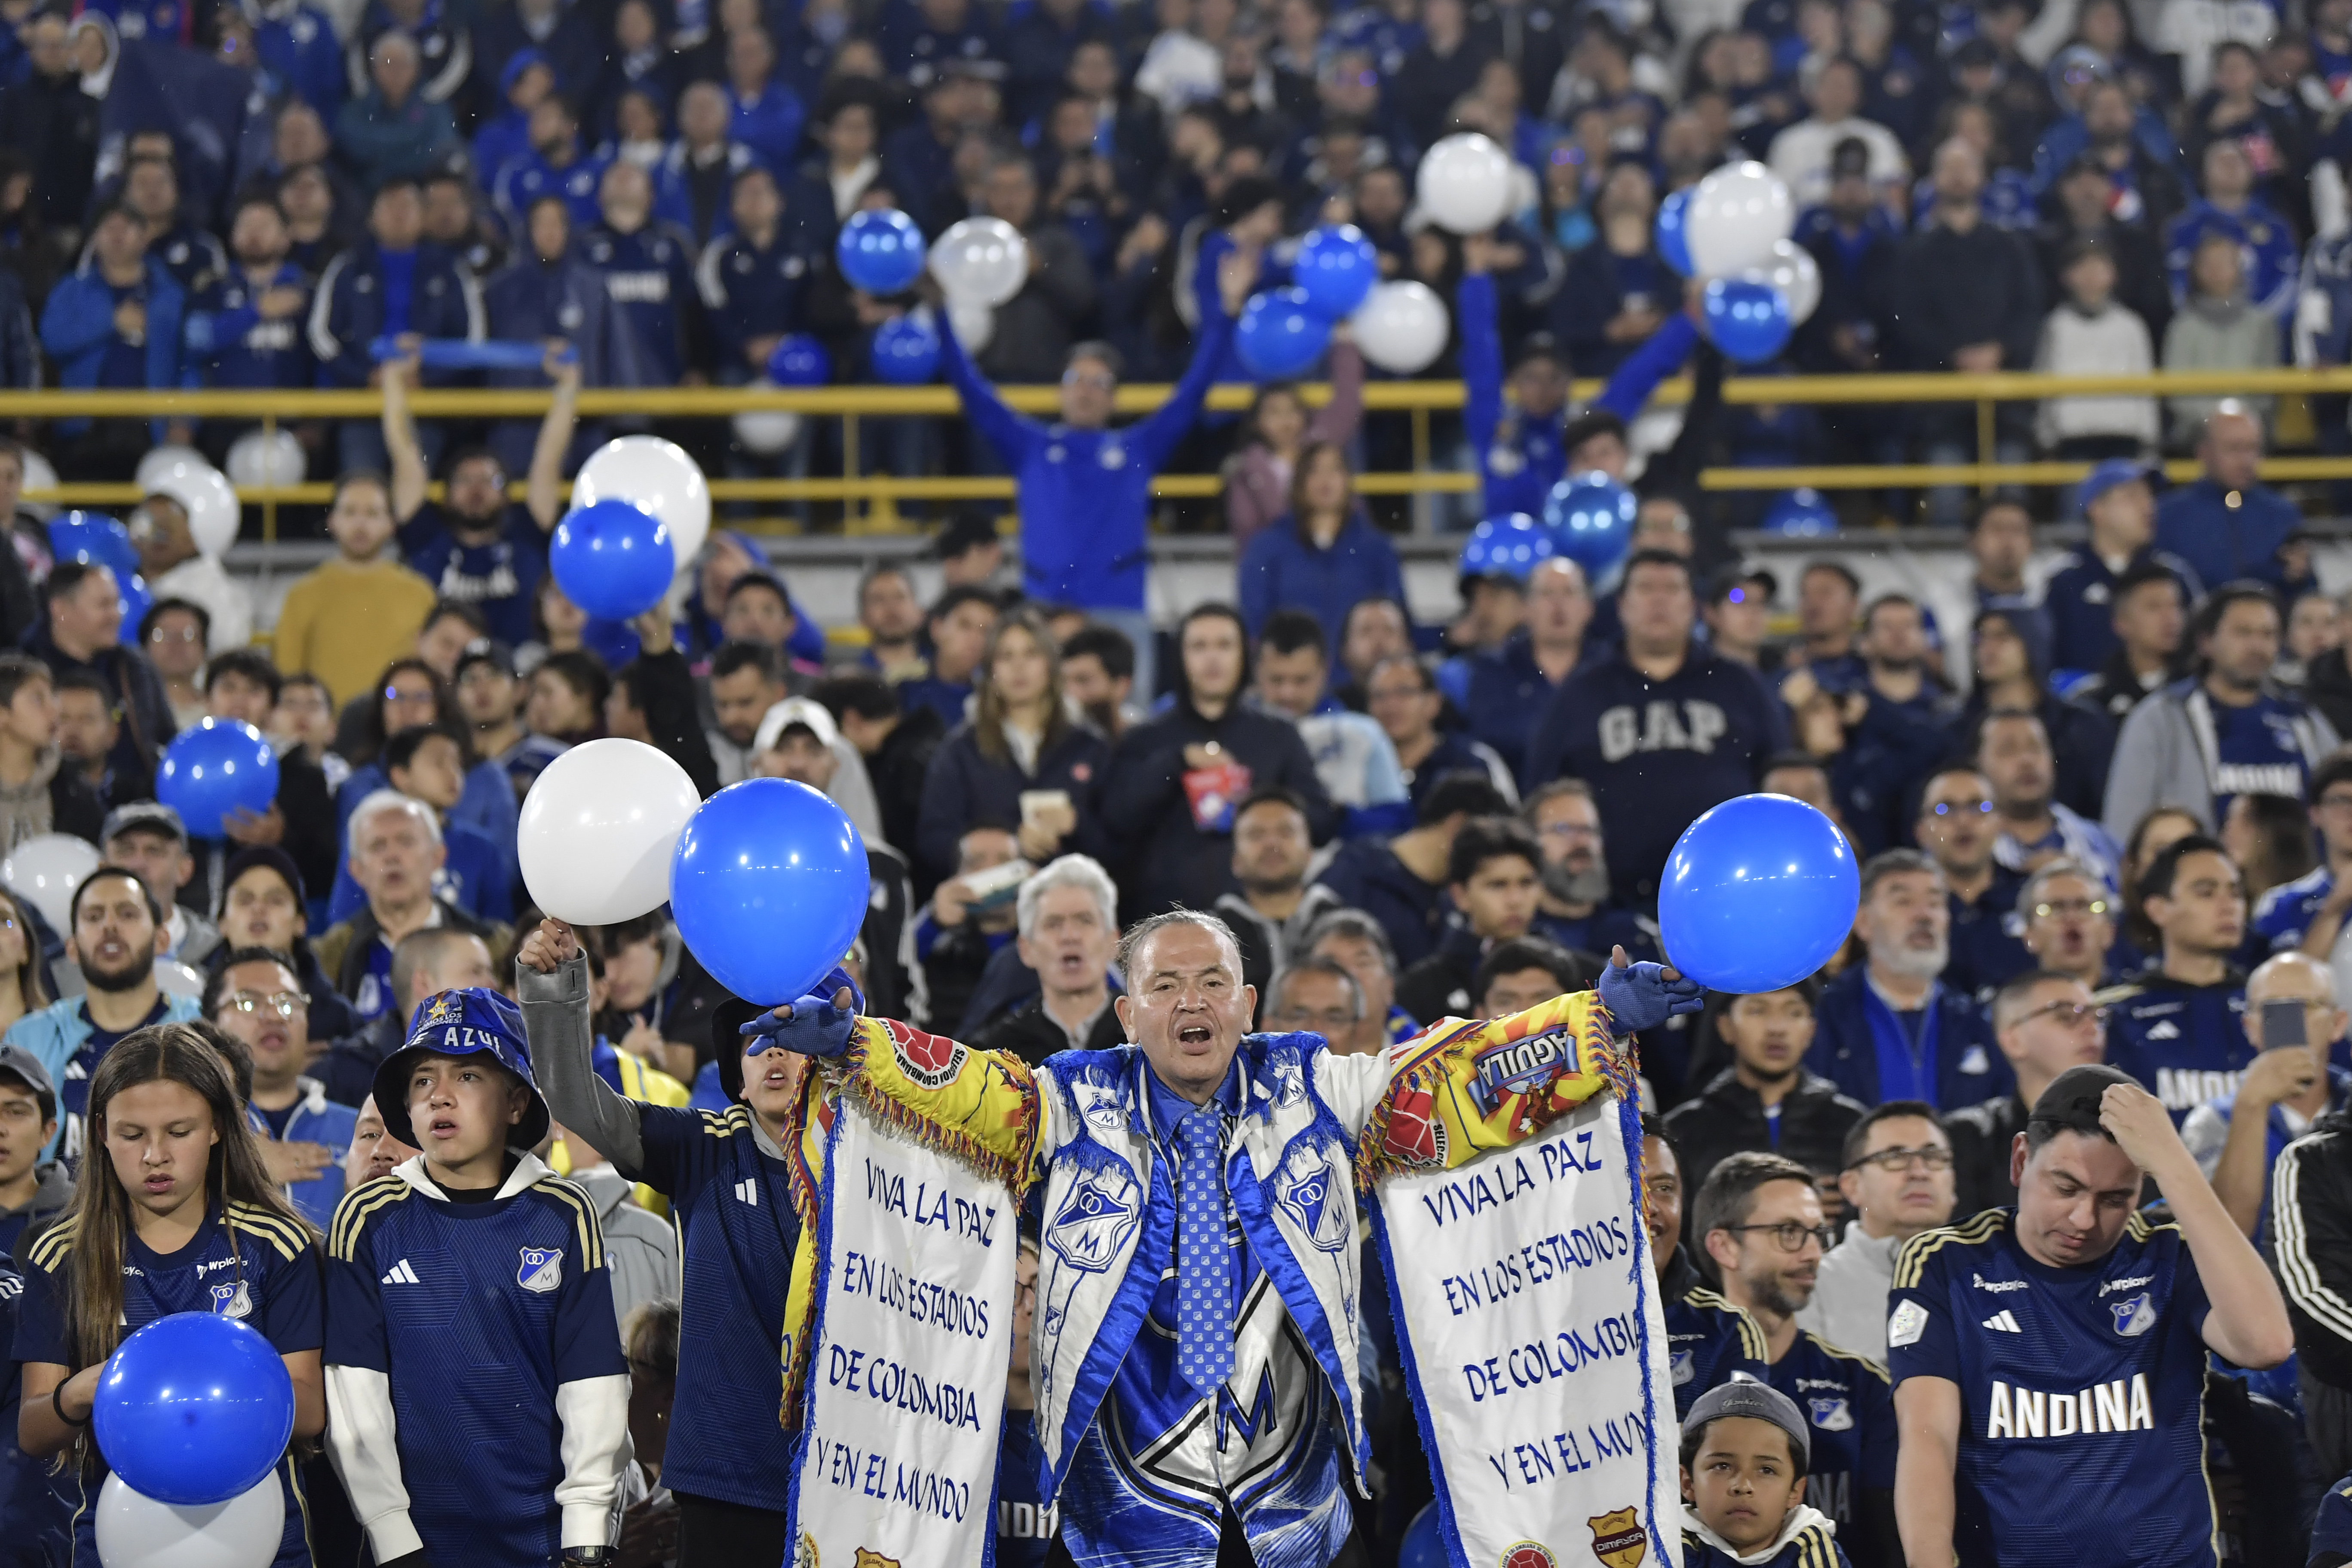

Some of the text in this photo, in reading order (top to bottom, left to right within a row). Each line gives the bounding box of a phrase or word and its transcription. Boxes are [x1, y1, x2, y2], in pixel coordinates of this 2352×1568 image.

[1598, 697, 1727, 764] GAP
[1477, 1031, 1568, 1087] AGUILA
[865, 1157, 996, 1248] VIVA LA PAZ
[1423, 1130, 1602, 1228] VIVA LA PAZ
[843, 1251, 988, 1339] EN LOS ESTADIOS
[1441, 1216, 1628, 1316] EN LOS ESTADIOS
[829, 1344, 981, 1433] DE COLOMBIA
[1462, 1356, 1508, 1402] DE
[1987, 1372, 2155, 1439] ANDINA
[817, 1436, 969, 1524] Y EN EL MUNDO
[1489, 1448, 1509, 1492] Y
[1513, 1437, 1555, 1485] EN
[1554, 1430, 1591, 1474] EL
